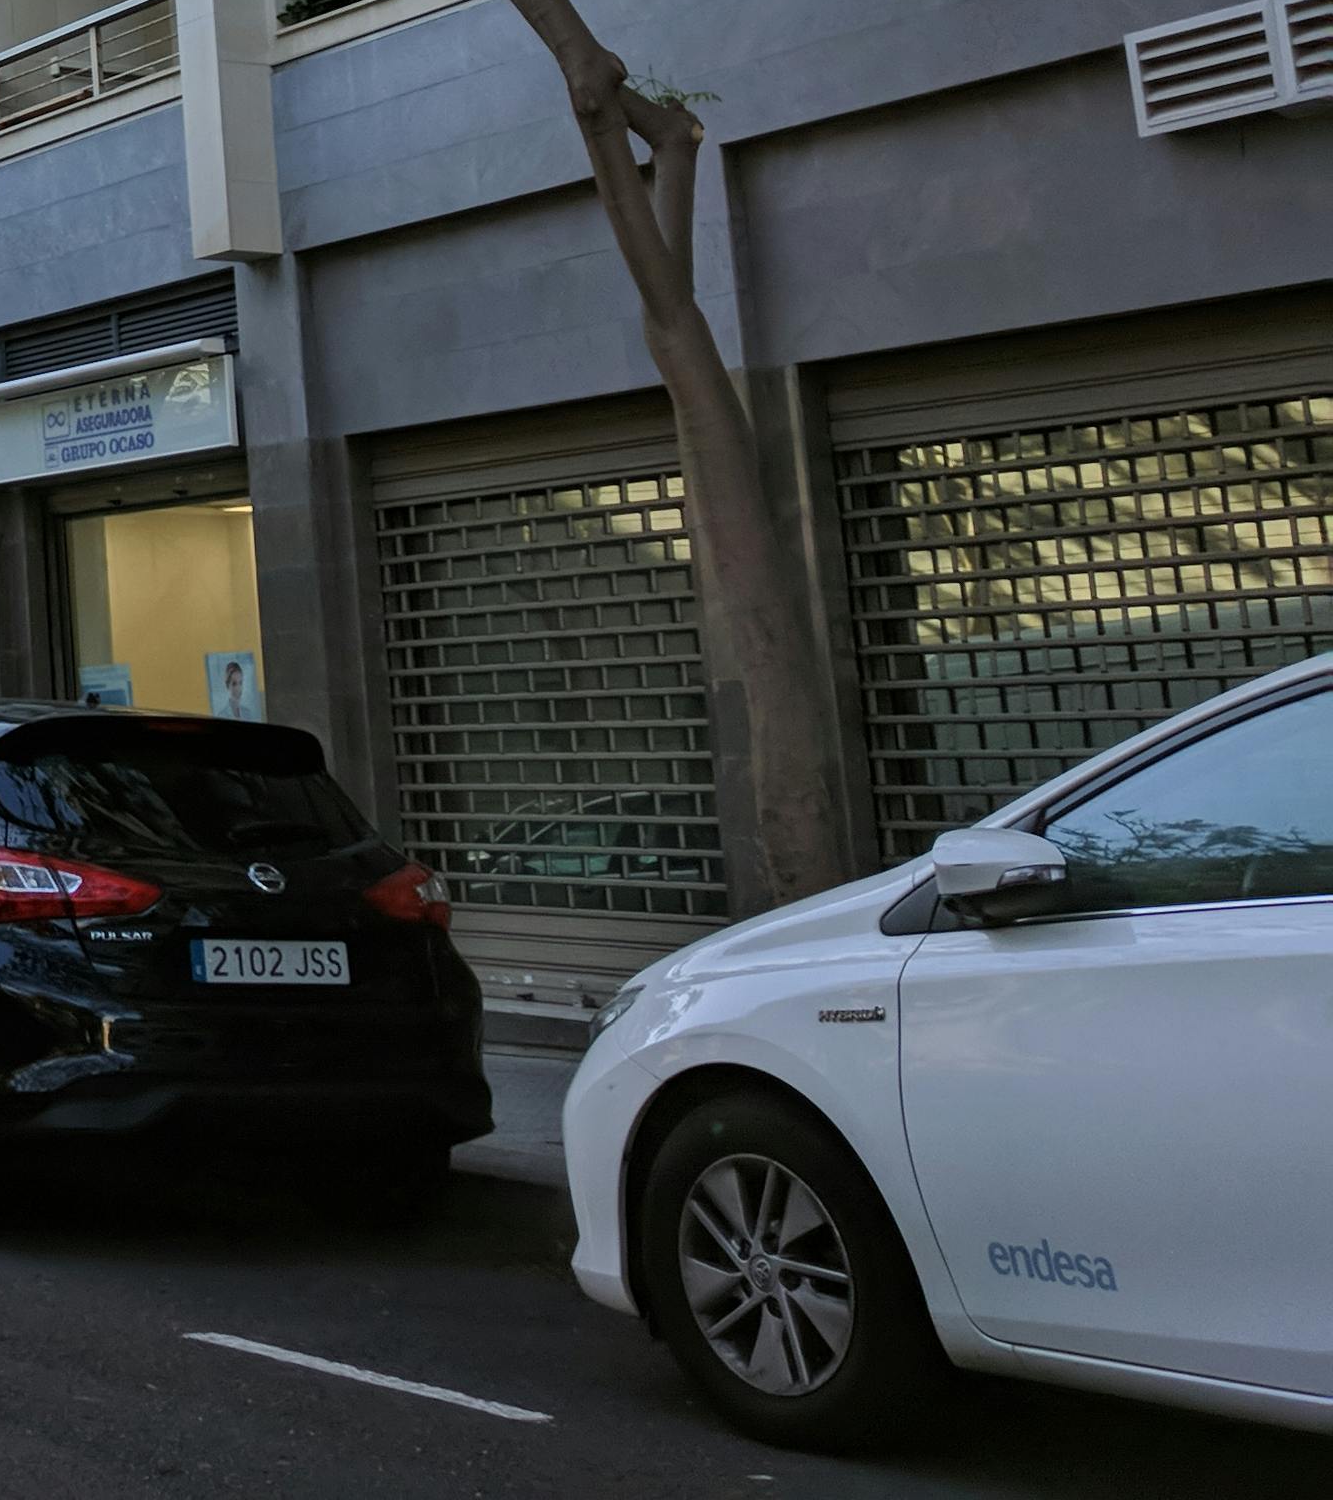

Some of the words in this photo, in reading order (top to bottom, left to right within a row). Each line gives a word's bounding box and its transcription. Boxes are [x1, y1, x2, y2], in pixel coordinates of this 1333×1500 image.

[74, 382, 151, 412] ETERNA
[76, 405, 152, 434] ASEGURADORA
[61, 441, 106, 463] GRUPO
[109, 432, 155, 454] OCASO
[90, 930, 153, 941] PULSAR
[212, 946, 284, 978] 2102
[295, 949, 342, 978] JSS
[988, 1238, 1119, 1292] endesa
